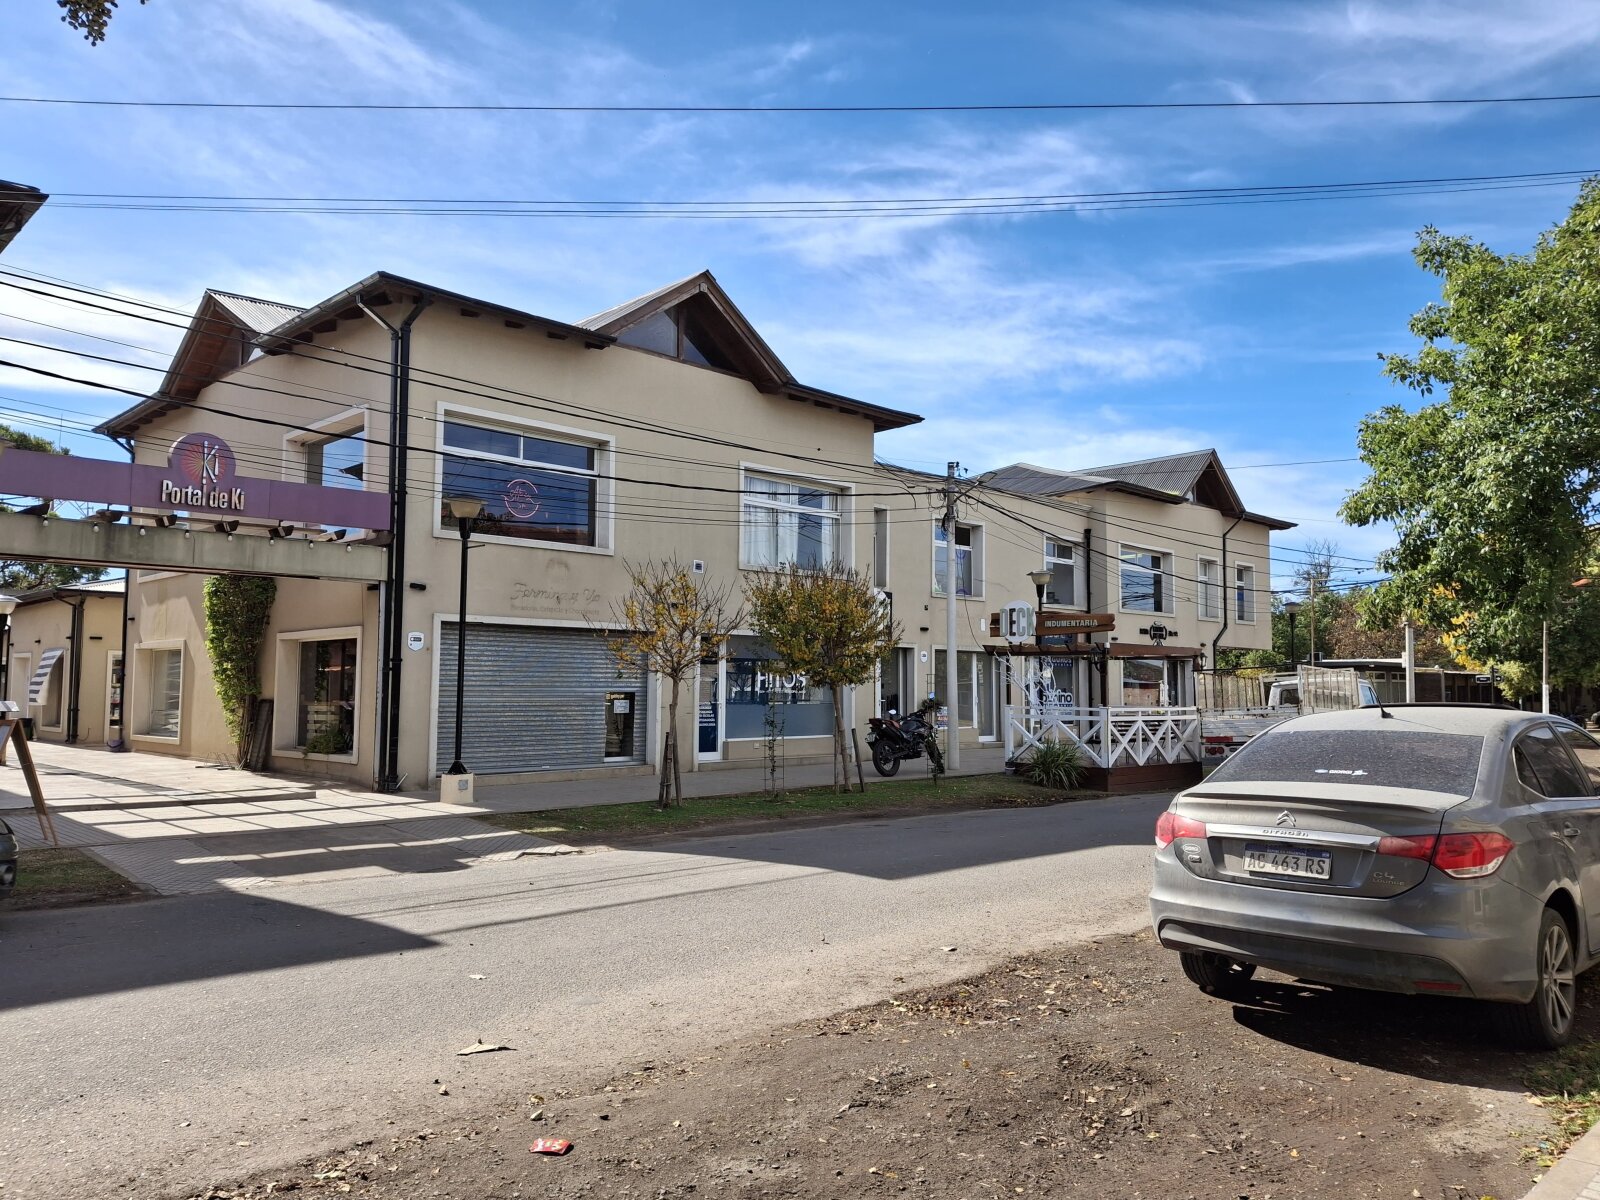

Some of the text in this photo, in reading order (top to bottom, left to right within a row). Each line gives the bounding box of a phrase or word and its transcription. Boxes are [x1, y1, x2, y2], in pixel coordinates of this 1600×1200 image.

[161, 479, 245, 510] Portal de Ki
[1000, 608, 1098, 637] DECK INDUMENTARIA
[1271, 855, 1299, 872] 463
[1305, 857, 1326, 875] RS
